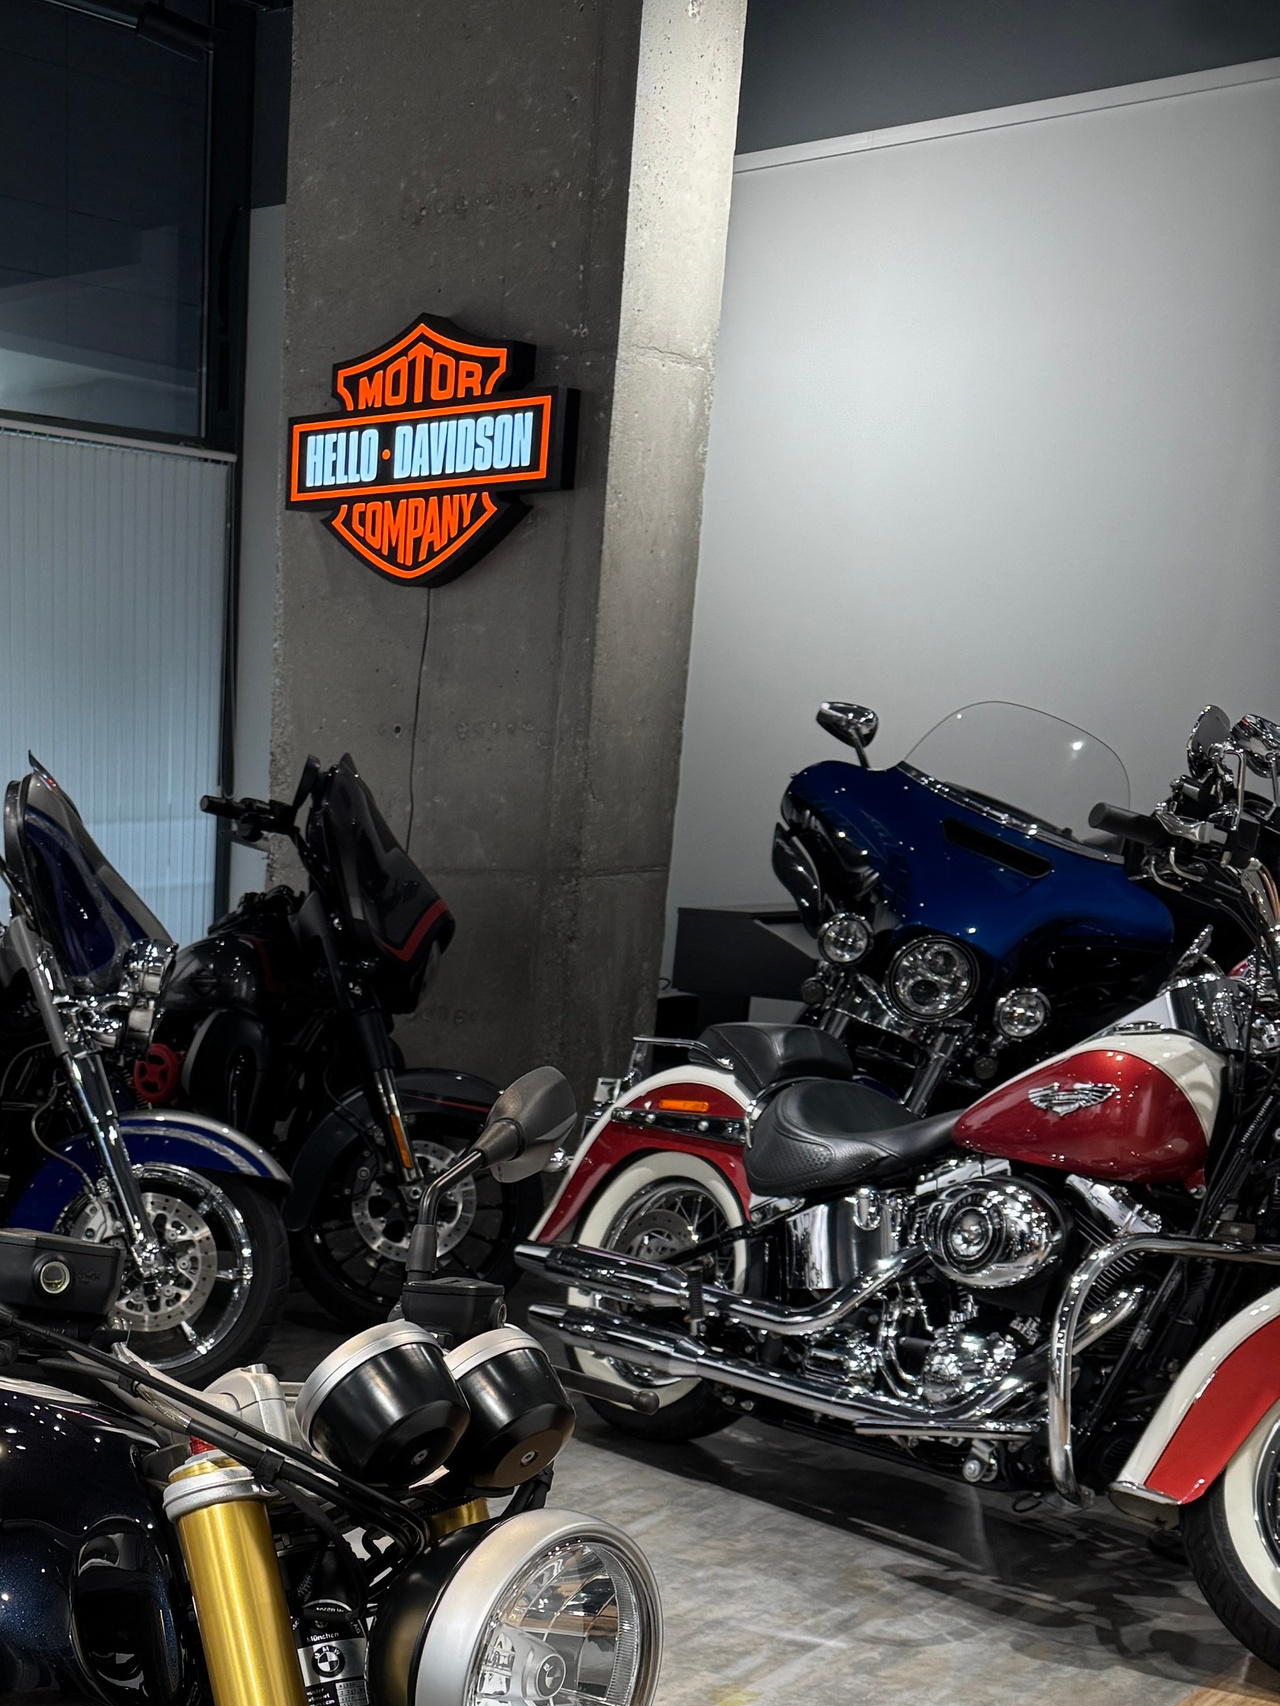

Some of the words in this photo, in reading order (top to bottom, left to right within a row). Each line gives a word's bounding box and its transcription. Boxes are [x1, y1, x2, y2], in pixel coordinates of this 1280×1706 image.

[358, 342, 482, 409] MOTOR
[306, 429, 379, 487] HELLO
[393, 411, 534, 479] DAVIDSON
[352, 493, 478, 566] COMPANY
